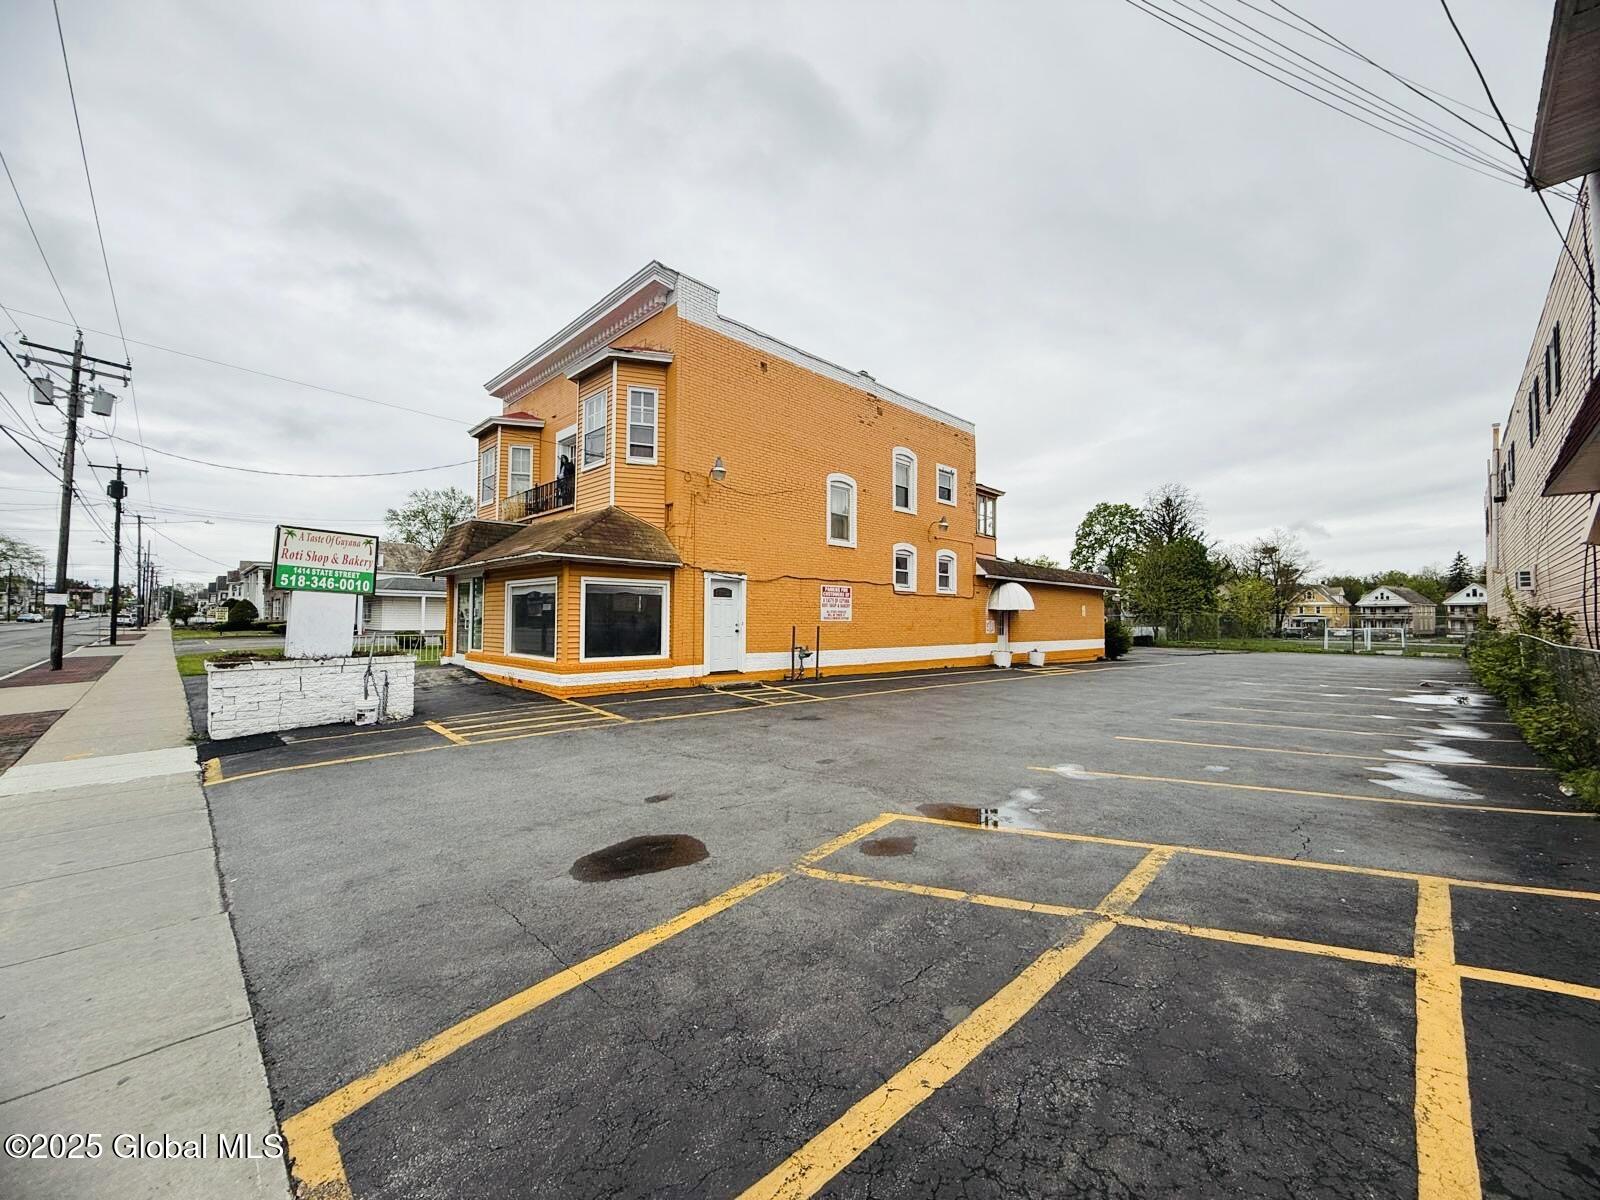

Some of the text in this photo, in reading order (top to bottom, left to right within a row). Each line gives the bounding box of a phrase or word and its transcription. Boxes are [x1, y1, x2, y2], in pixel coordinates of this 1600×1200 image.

[298, 531, 361, 549] A Taste Of Guyana
[281, 547, 373, 571] Roti Shop & Bakery
[293, 567, 361, 579] 1414 STATE STREET
[280, 573, 370, 592] 518-346-0010
